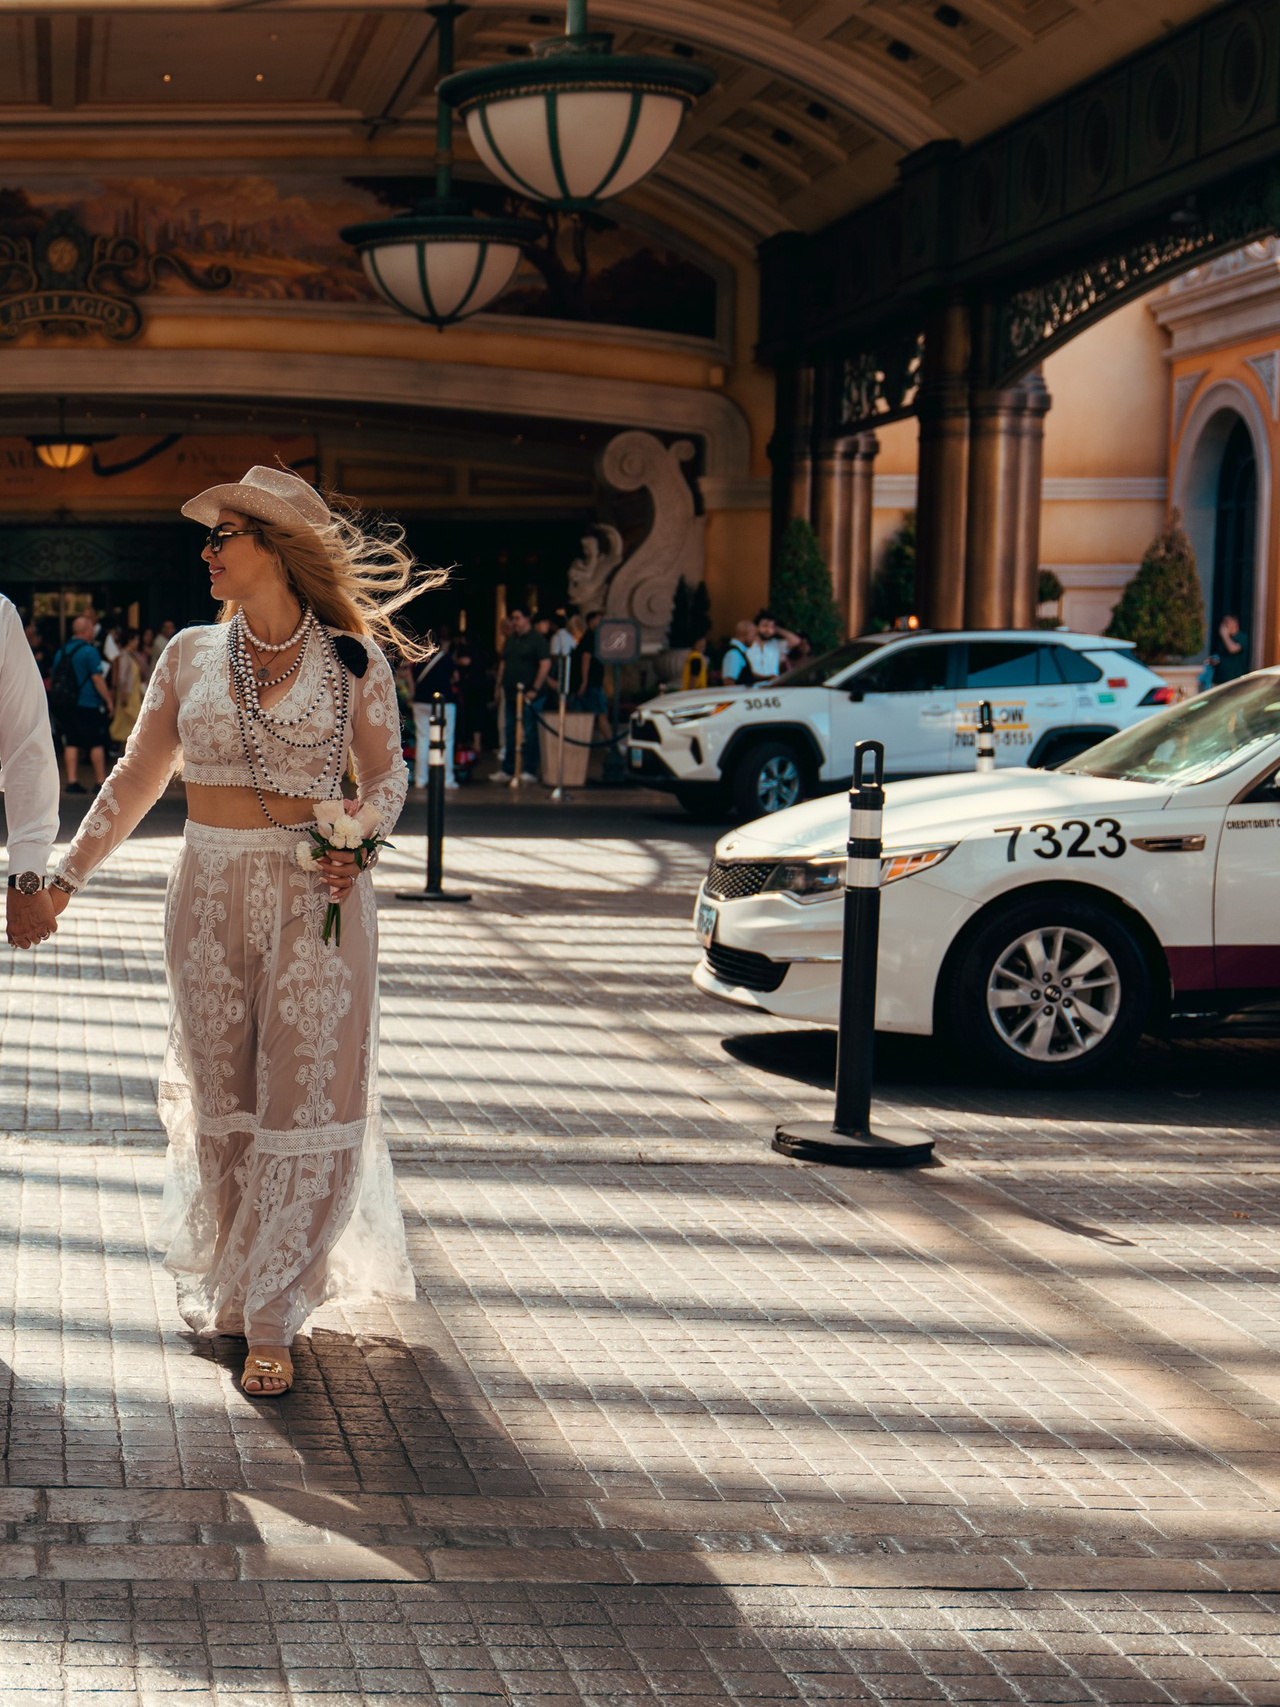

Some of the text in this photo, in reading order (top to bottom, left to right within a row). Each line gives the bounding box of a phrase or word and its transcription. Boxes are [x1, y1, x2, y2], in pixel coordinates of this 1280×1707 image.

[9, 295, 121, 320] BELLAGIO
[744, 697, 782, 711] 3046
[963, 707, 1024, 723] YELOW
[993, 818, 1127, 862] 7323
